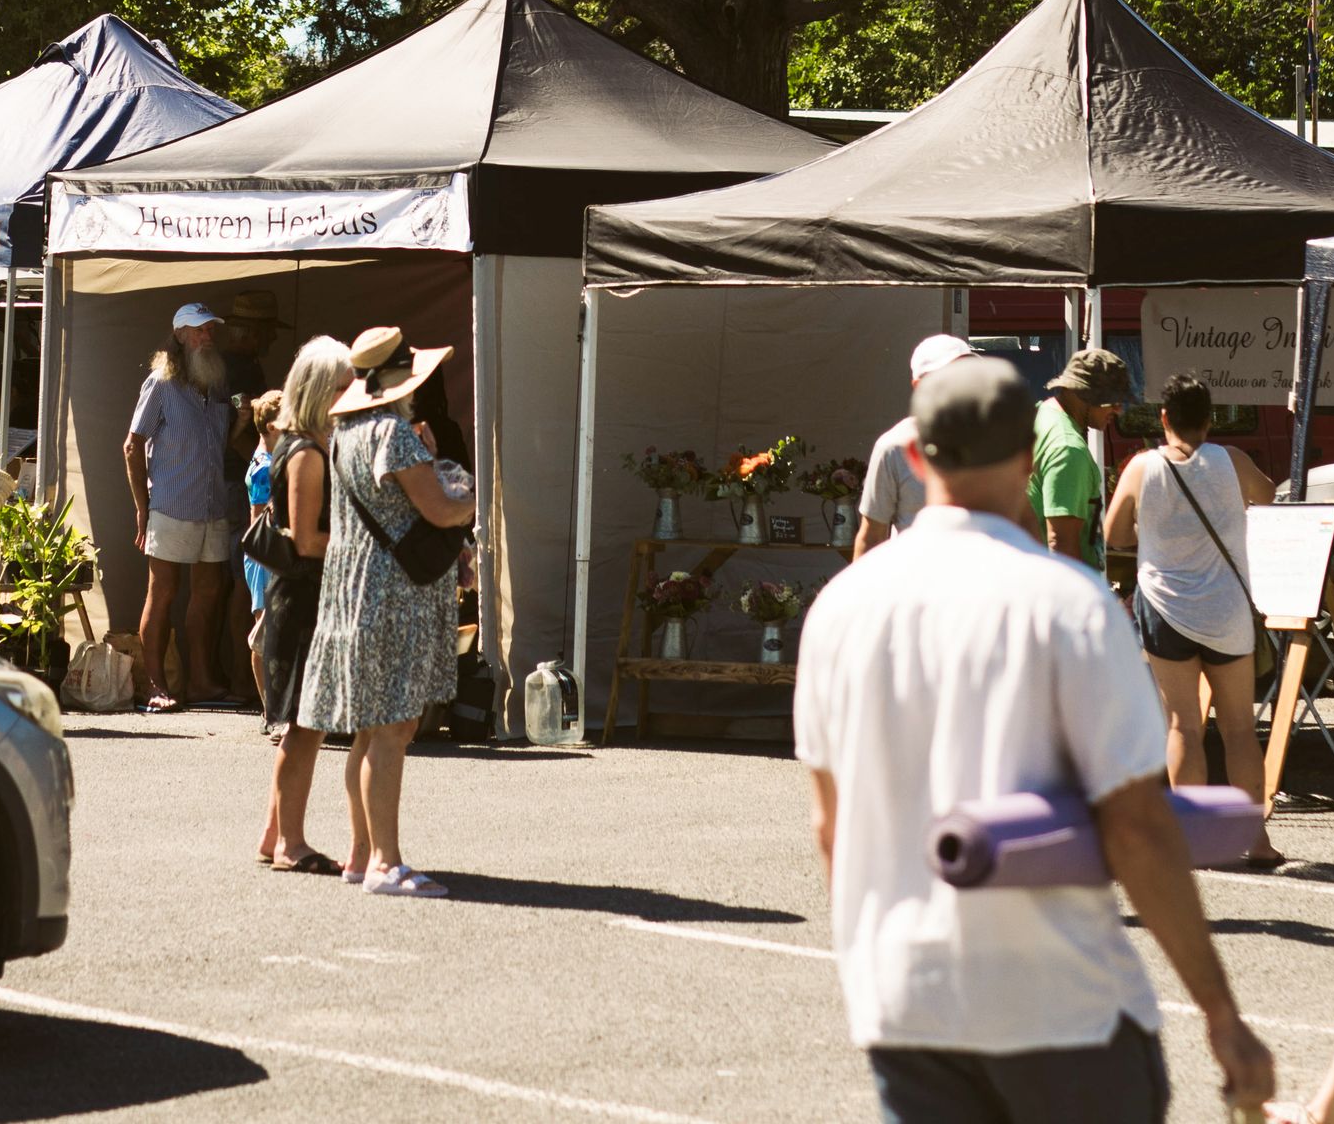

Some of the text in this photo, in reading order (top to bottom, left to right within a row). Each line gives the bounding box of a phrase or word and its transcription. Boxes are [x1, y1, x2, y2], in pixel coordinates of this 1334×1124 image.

[133, 206, 252, 239] Henwen
[1161, 316, 1256, 360] Vintage
[1251, 377, 1267, 388] on
